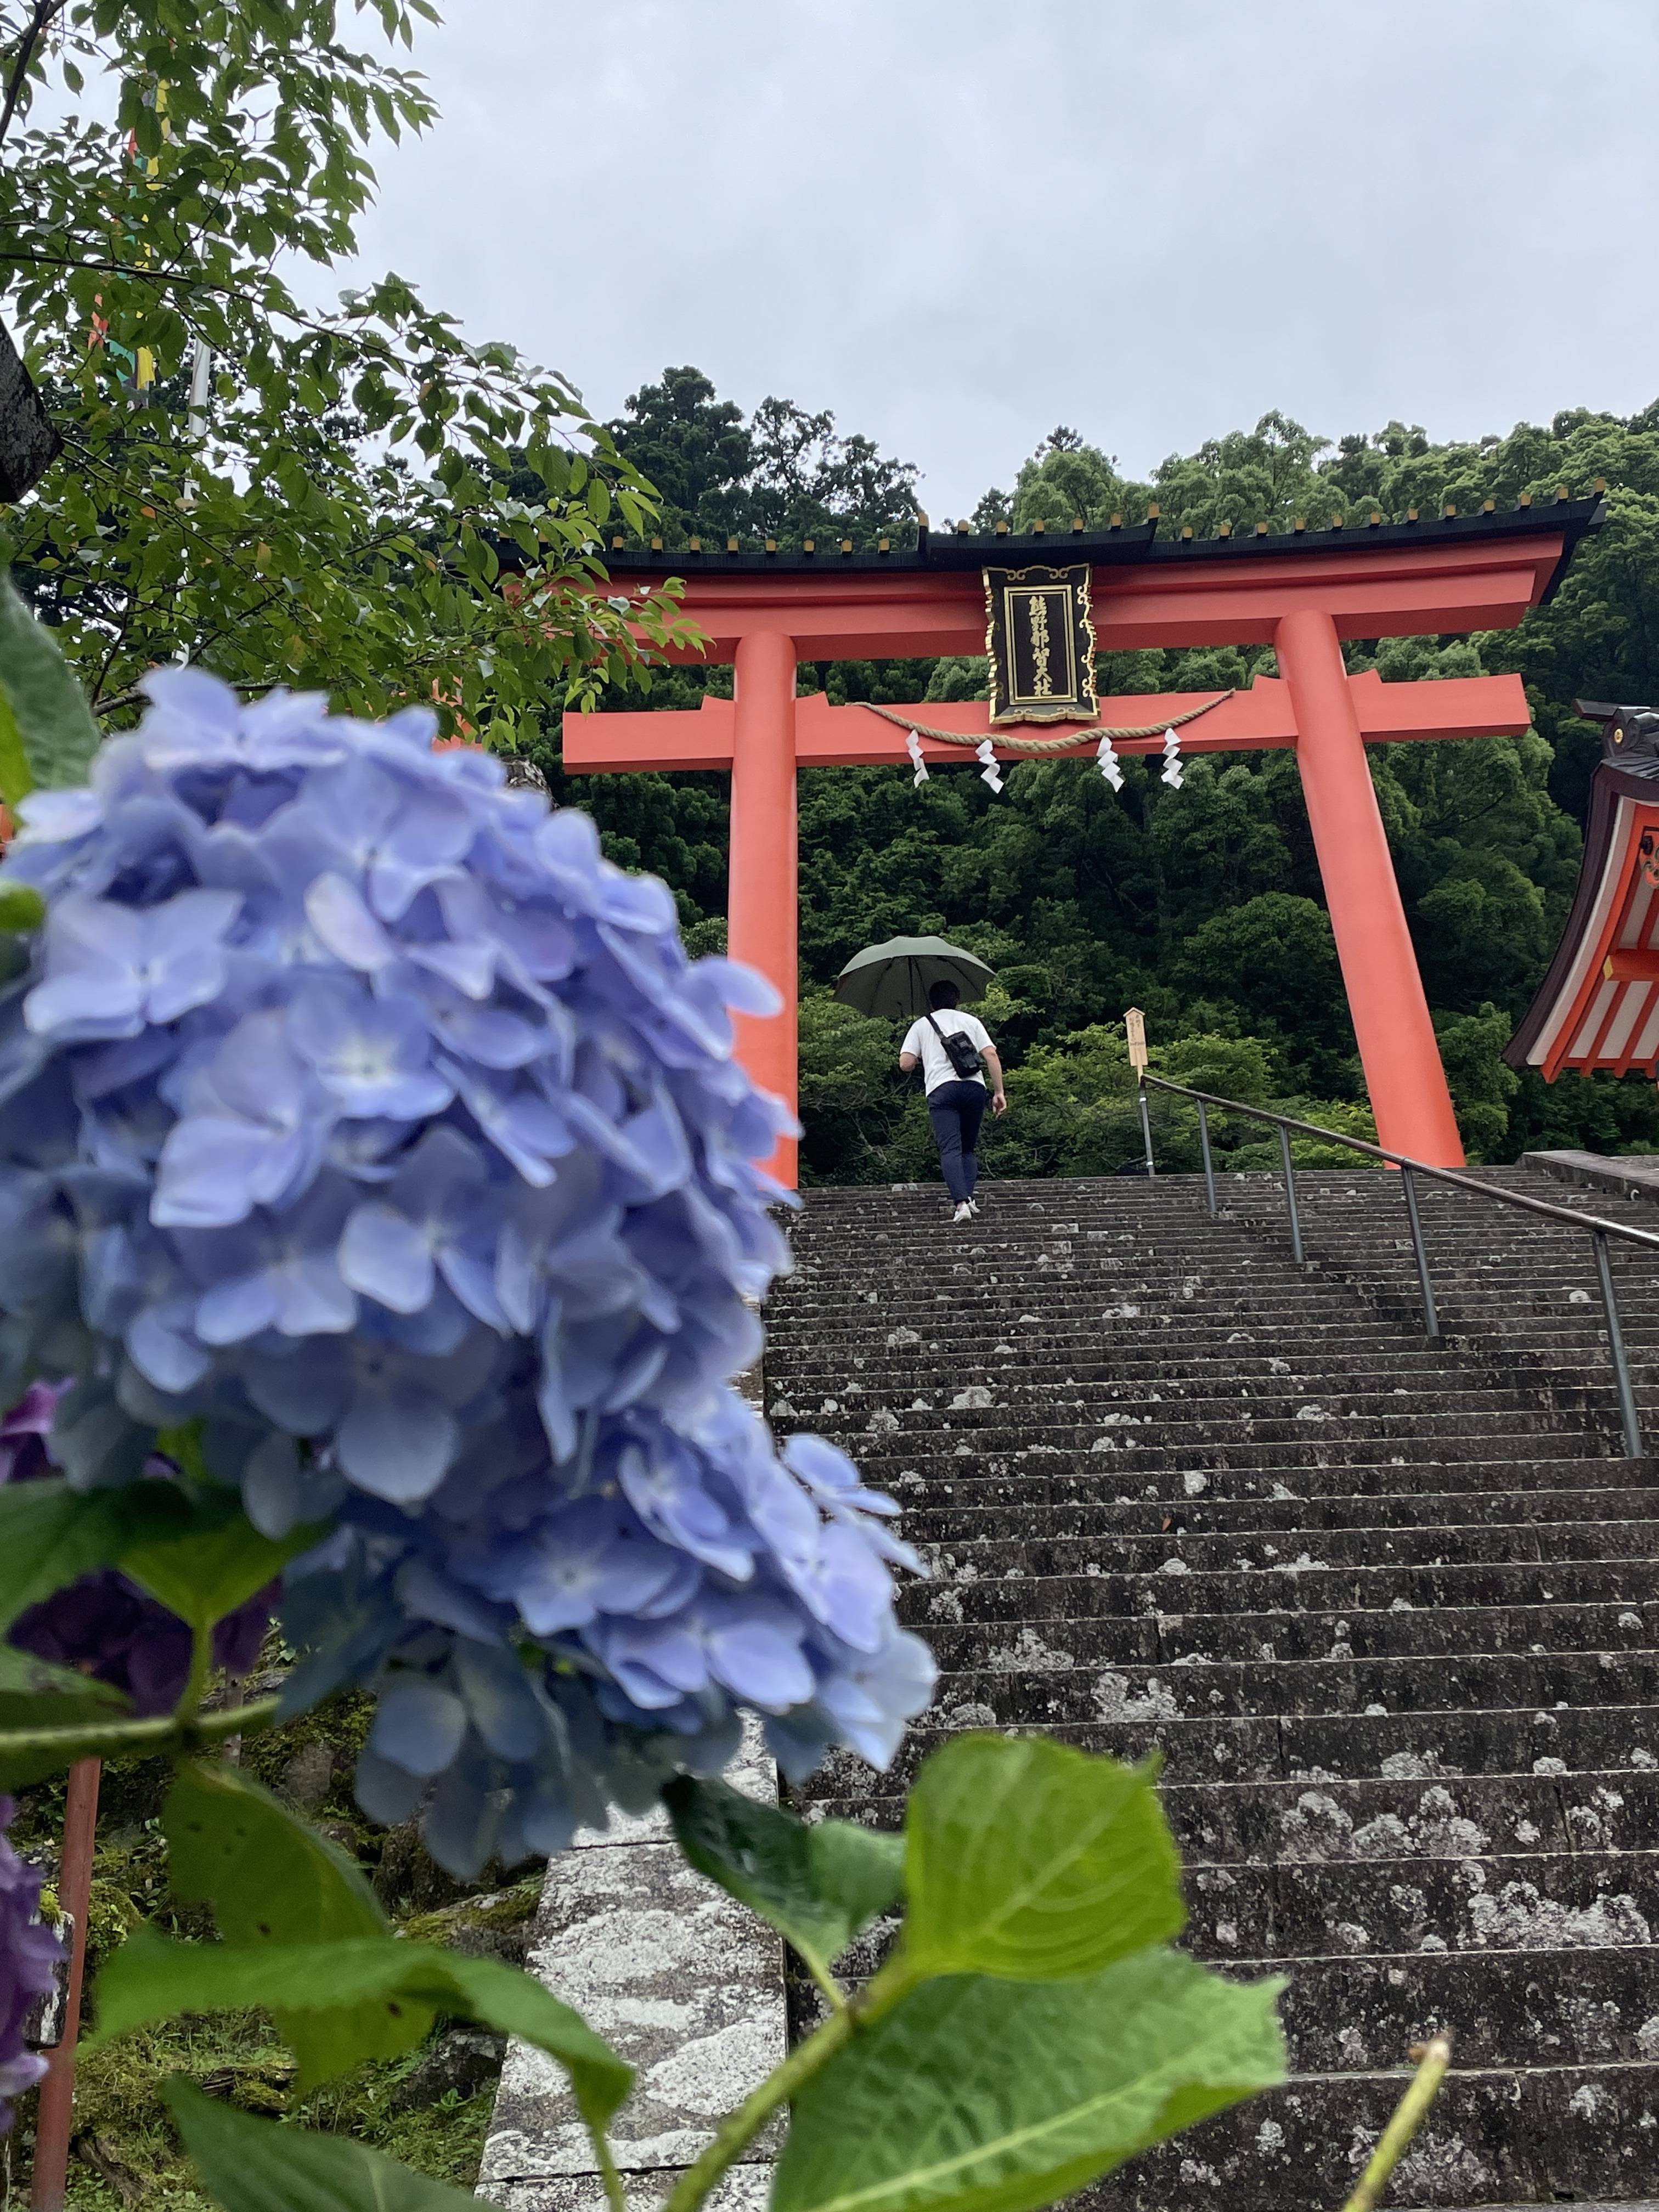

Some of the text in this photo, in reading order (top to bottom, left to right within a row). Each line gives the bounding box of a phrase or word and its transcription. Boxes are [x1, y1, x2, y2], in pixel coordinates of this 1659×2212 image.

[1029, 595, 1052, 697] 熊野那智大社
